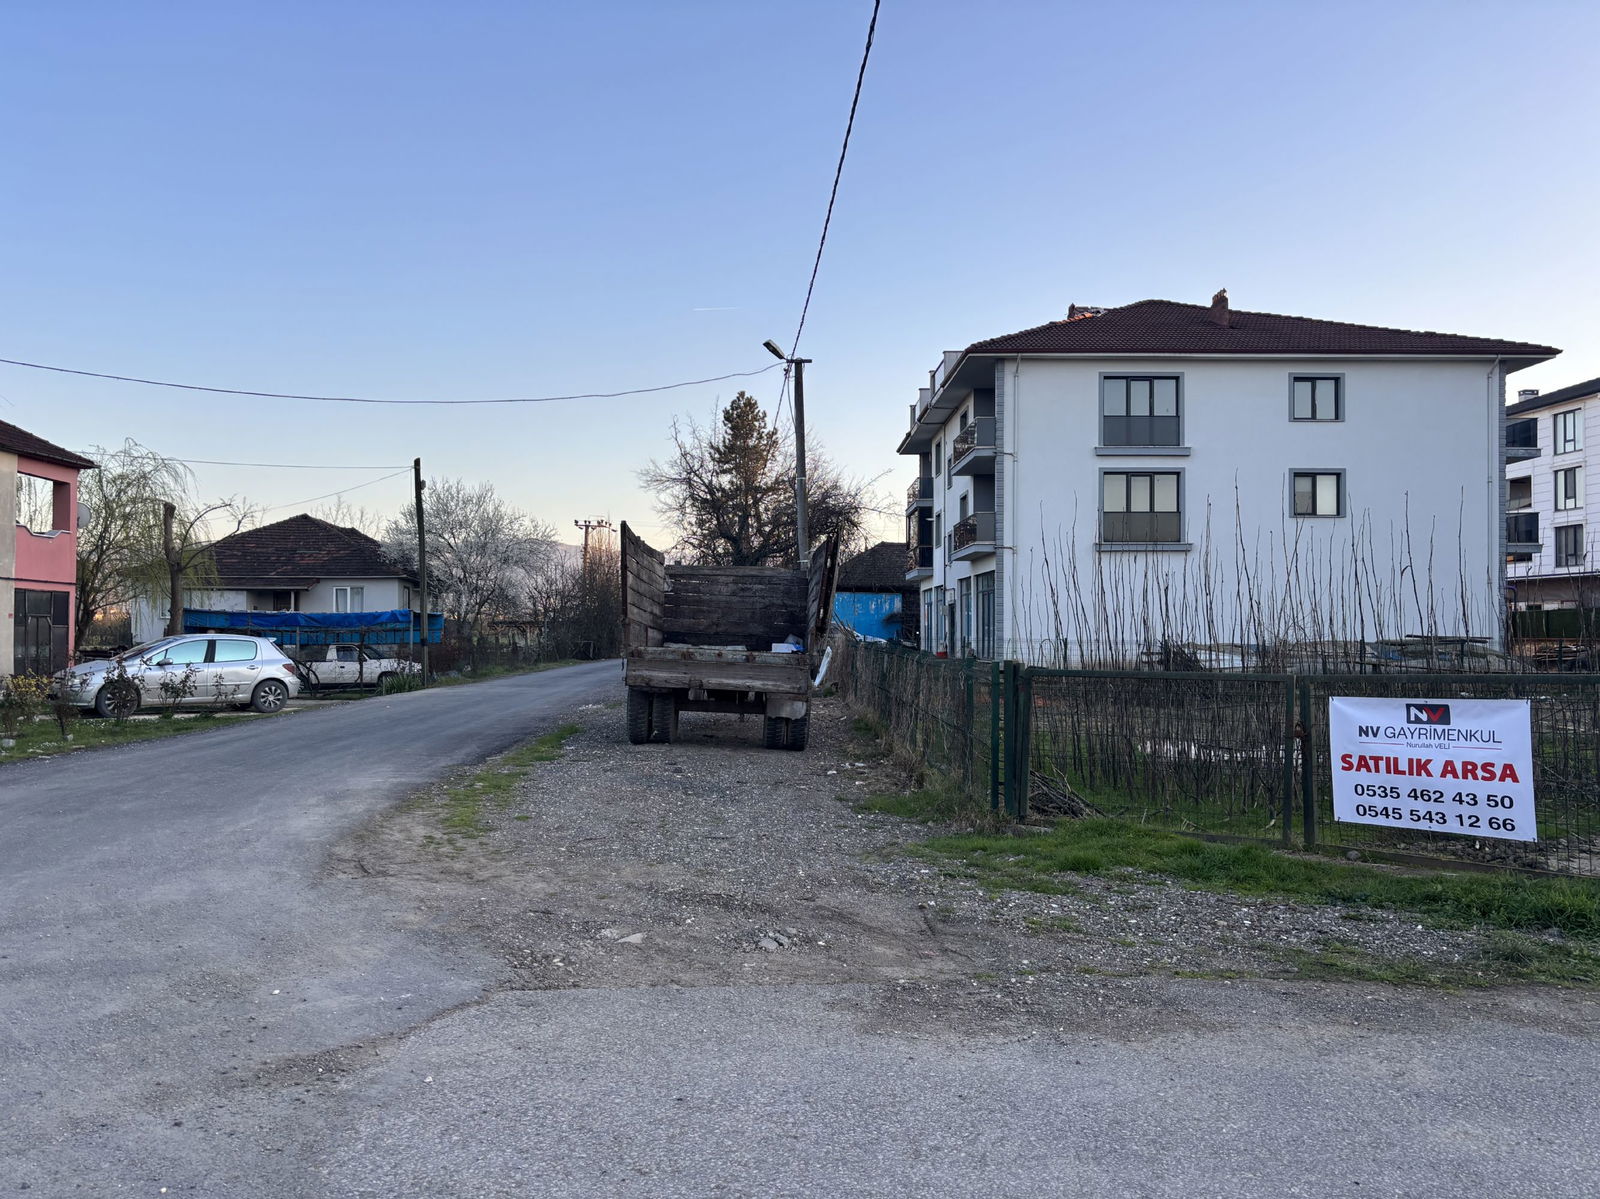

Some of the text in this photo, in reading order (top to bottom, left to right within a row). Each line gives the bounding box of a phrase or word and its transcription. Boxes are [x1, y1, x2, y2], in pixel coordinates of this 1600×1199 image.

[1409, 706, 1446, 723] NV
[1358, 725, 1503, 744] NV GAYRİMENKUL
[1340, 753, 1520, 784] SATILIK ARSA
[1354, 783, 1514, 809] 0535 462 43 50
[1355, 804, 1516, 832] 0545 543 12 66
